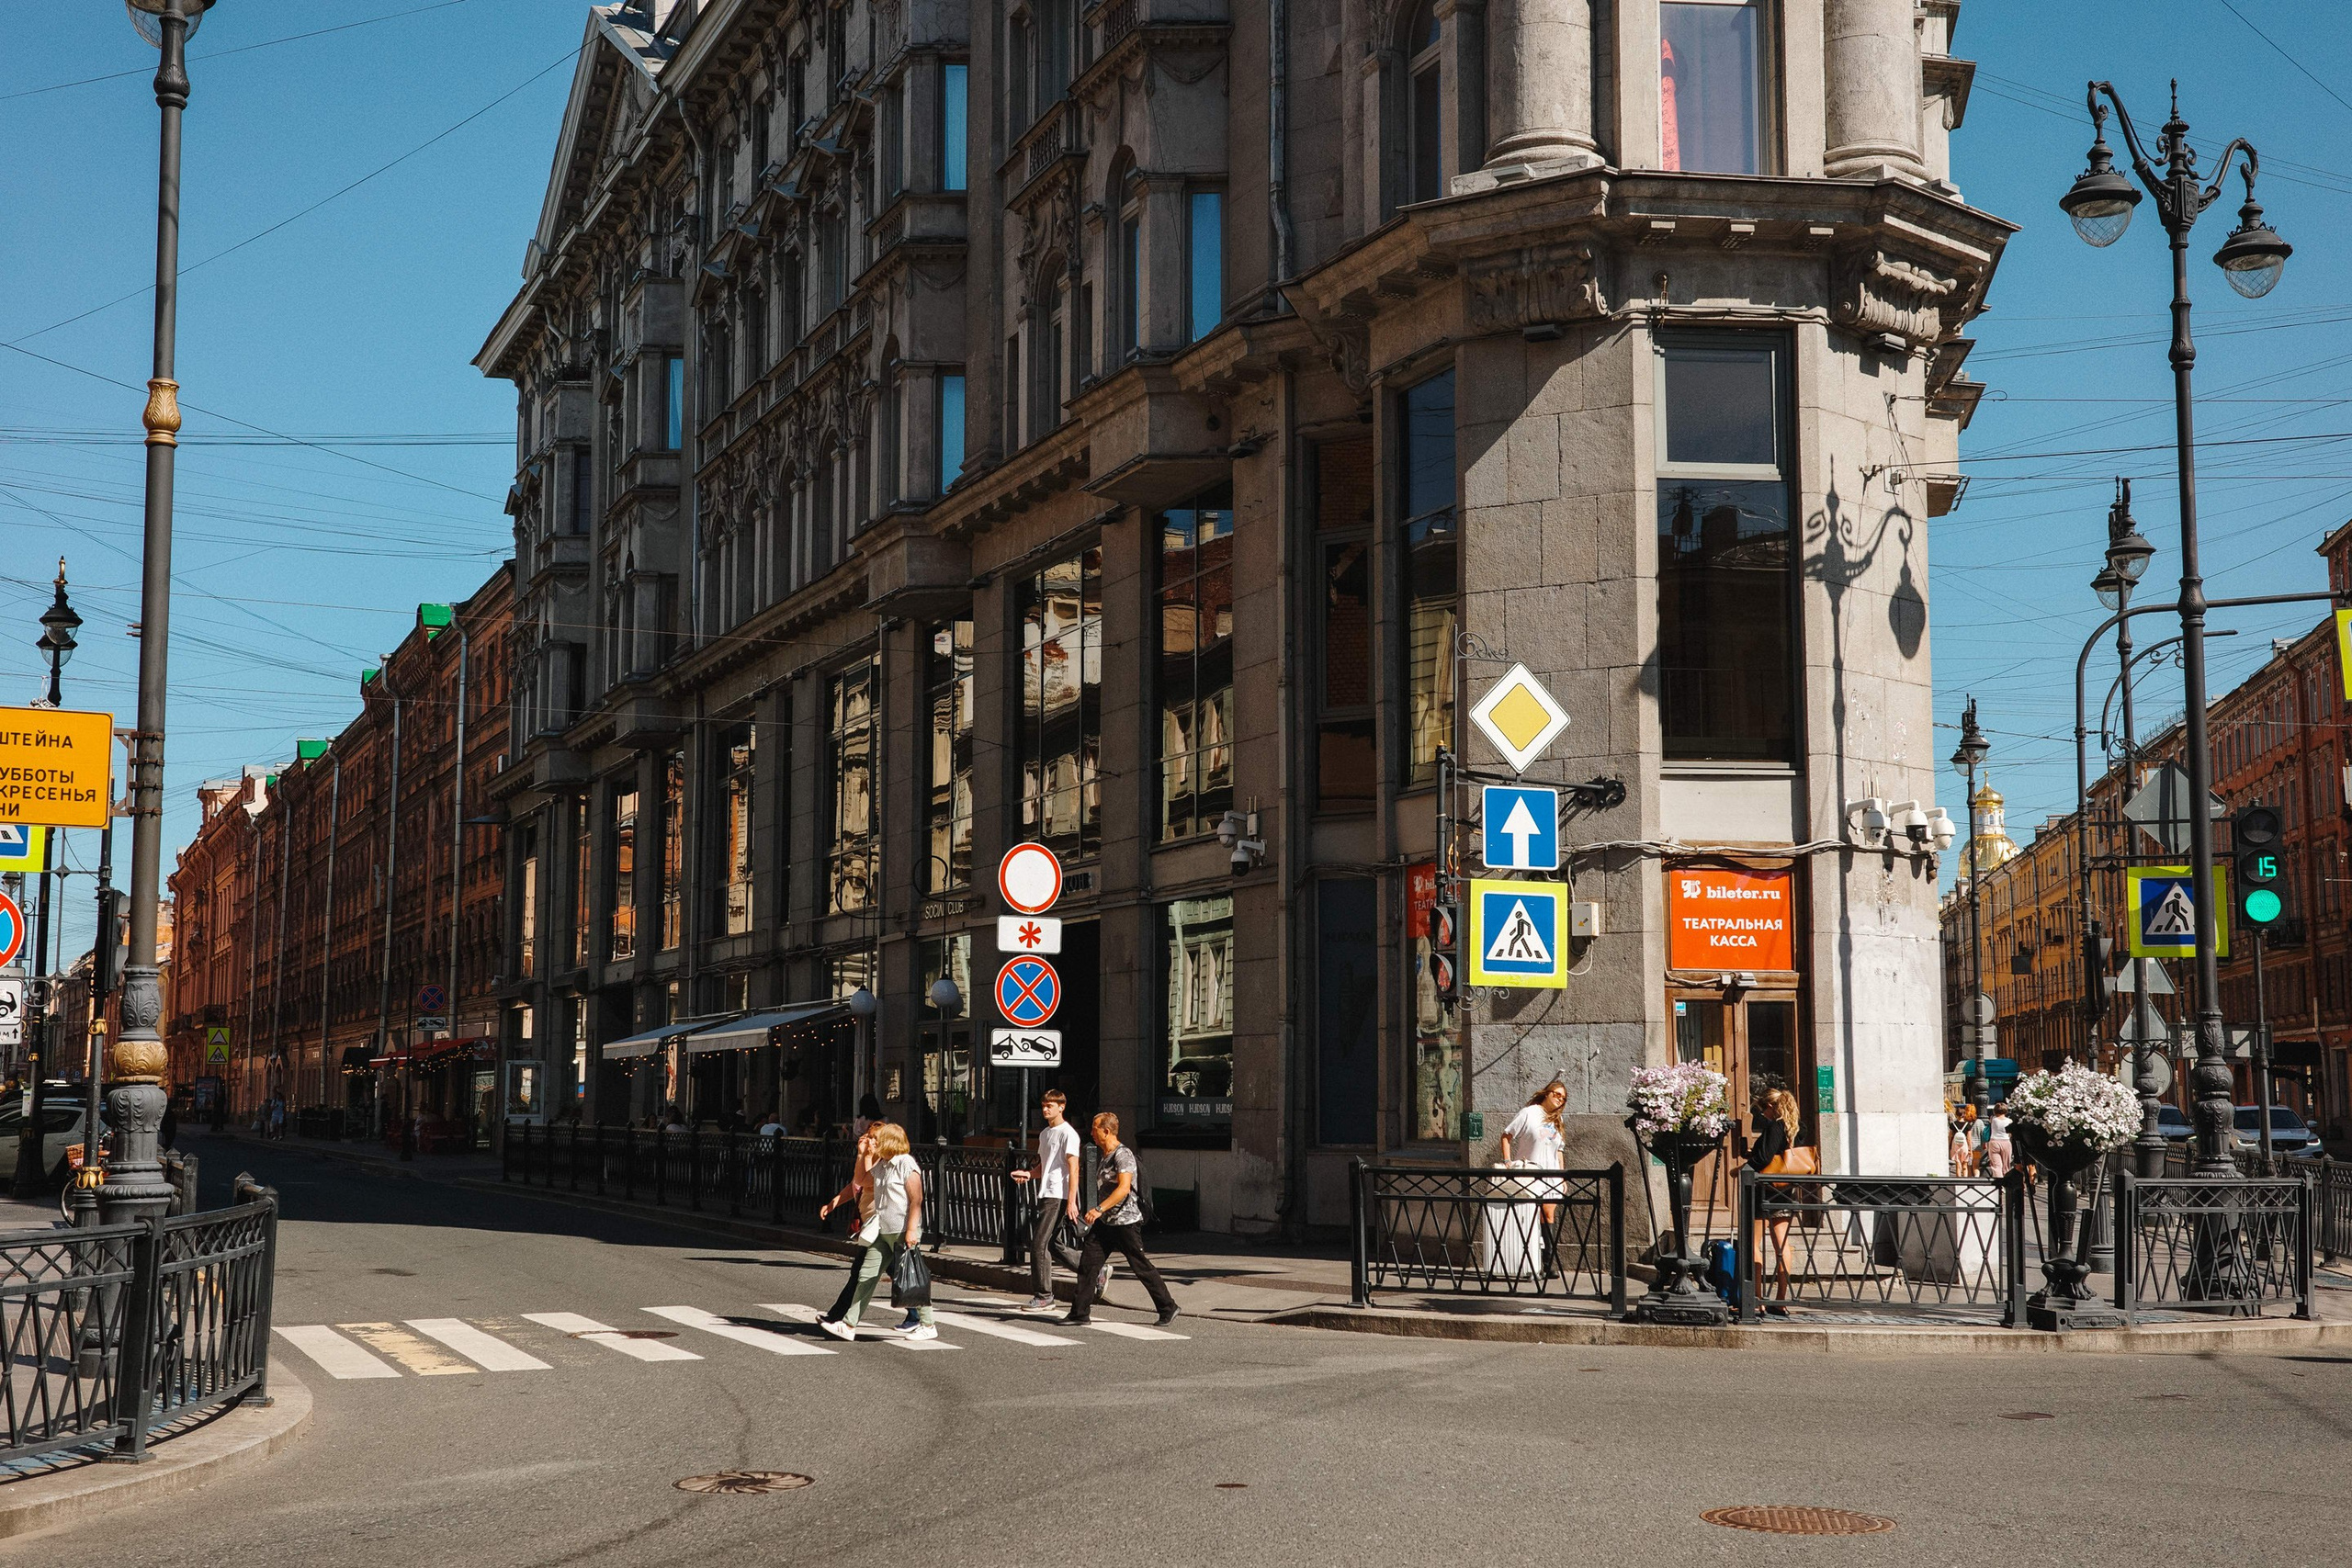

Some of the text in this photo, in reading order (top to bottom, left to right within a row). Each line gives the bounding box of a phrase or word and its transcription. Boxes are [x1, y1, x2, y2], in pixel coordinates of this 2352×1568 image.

[0, 767, 74, 784] УББОТЫ
[2258, 856, 2278, 877] 15
[1706, 886, 1781, 900] bileter.ru
[947, 898, 965, 915] CLUB
[1682, 917, 1783, 931] ТЕАТРАЛЬНАЯ
[1709, 934, 1758, 947] КАССА
[1189, 1103, 1211, 1113] HUDSON
